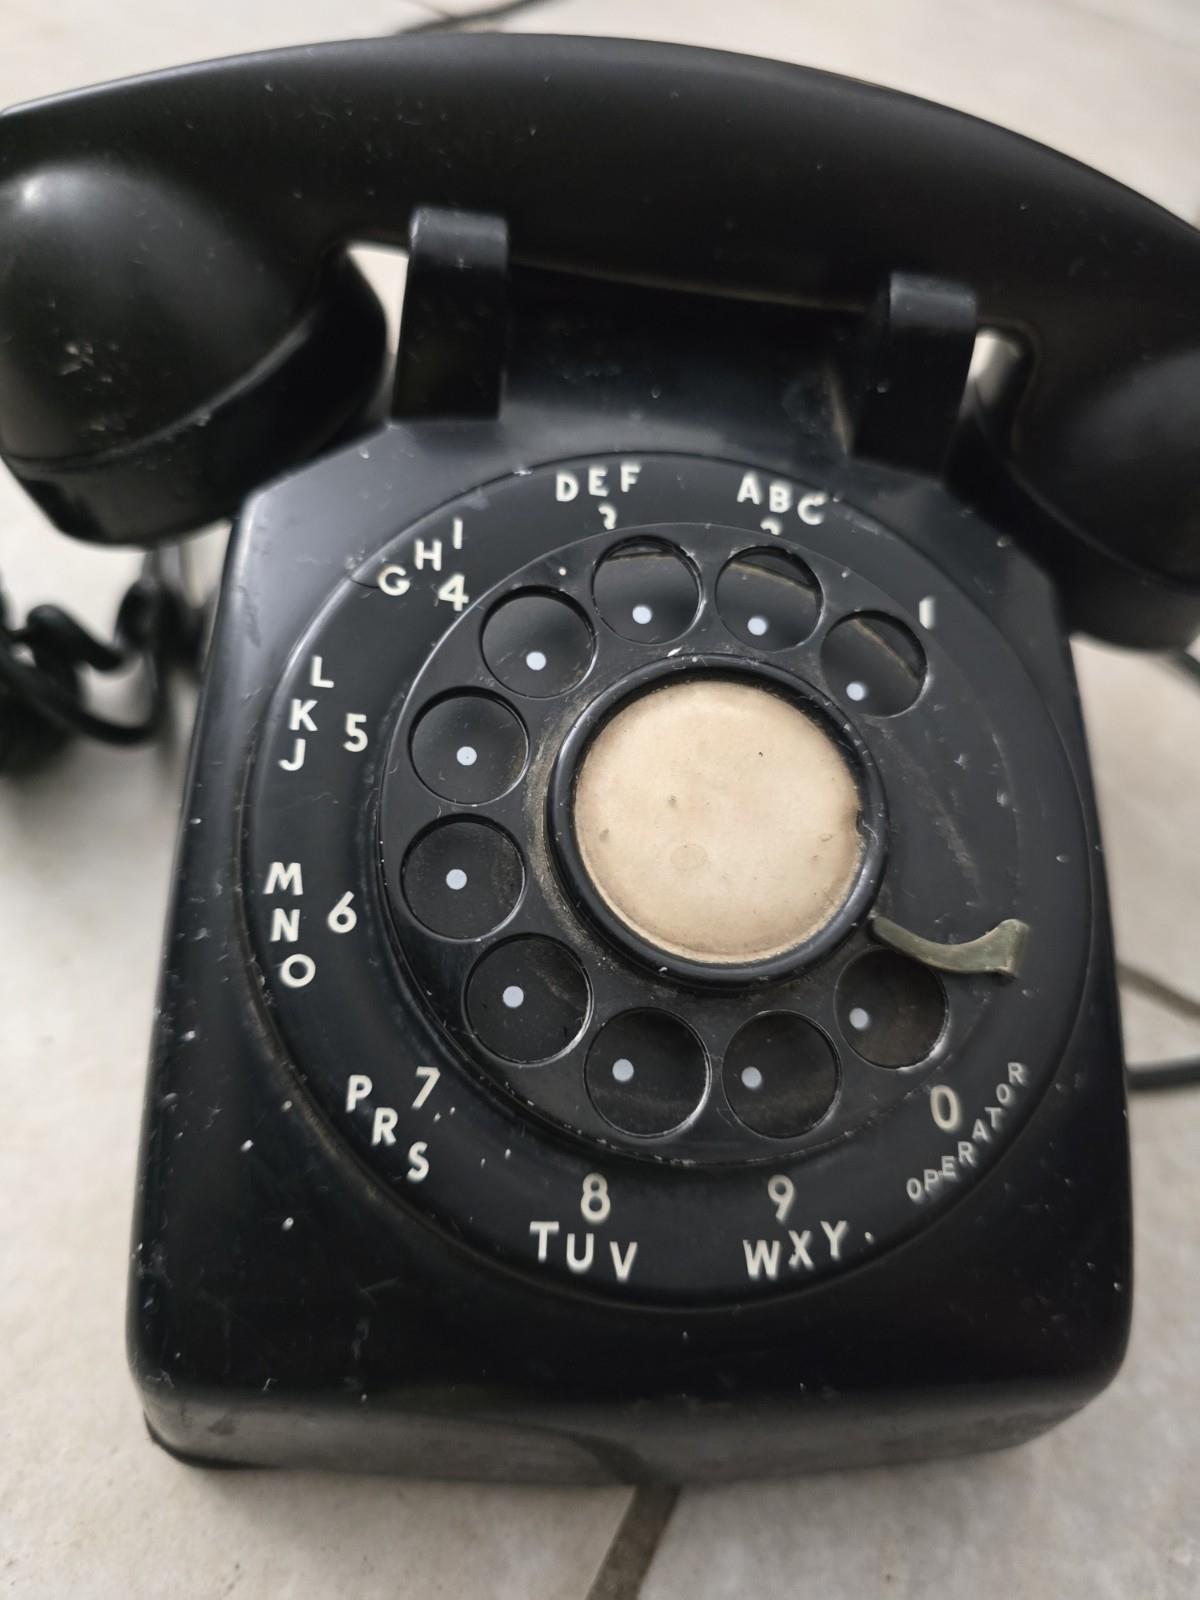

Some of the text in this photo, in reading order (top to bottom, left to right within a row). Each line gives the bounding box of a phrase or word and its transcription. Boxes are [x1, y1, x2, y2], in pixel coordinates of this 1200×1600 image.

[555, 462, 641, 502] DEF
[736, 471, 827, 525] ABC
[377, 518, 464, 596] GHI
[438, 574, 469, 611] 4
[343, 713, 368, 752] 5
[327, 891, 357, 934] 6
[411, 1066, 441, 1109] 7
[930, 1084, 961, 1131] 0
[345, 1074, 430, 1182] PRS
[906, 1062, 1027, 1203] OPERATOR
[580, 1173, 611, 1223] 8
[767, 1174, 794, 1223] 9
[529, 1221, 638, 1281] TUV
[742, 1220, 848, 1279] WXY
